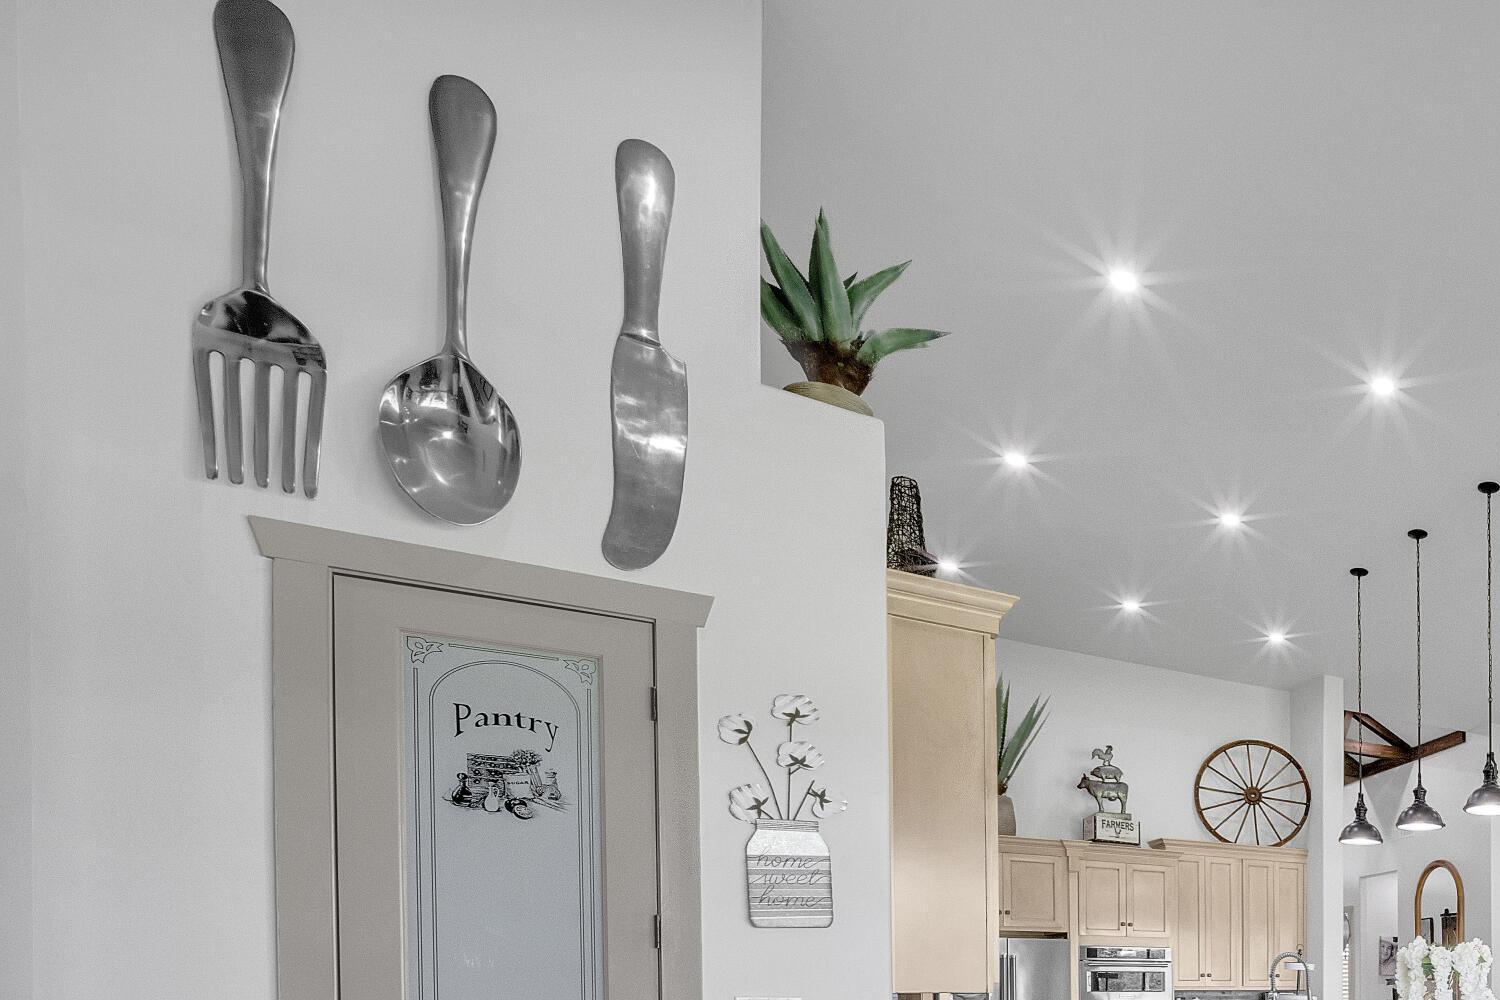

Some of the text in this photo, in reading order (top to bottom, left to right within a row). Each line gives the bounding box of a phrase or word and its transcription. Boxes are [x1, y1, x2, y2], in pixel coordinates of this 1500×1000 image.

[453, 702, 559, 752] Pantry
[1102, 819, 1134, 831] FARMERS
[749, 847, 829, 868] home
[750, 869, 829, 885] sweet
[752, 885, 831, 907] home
